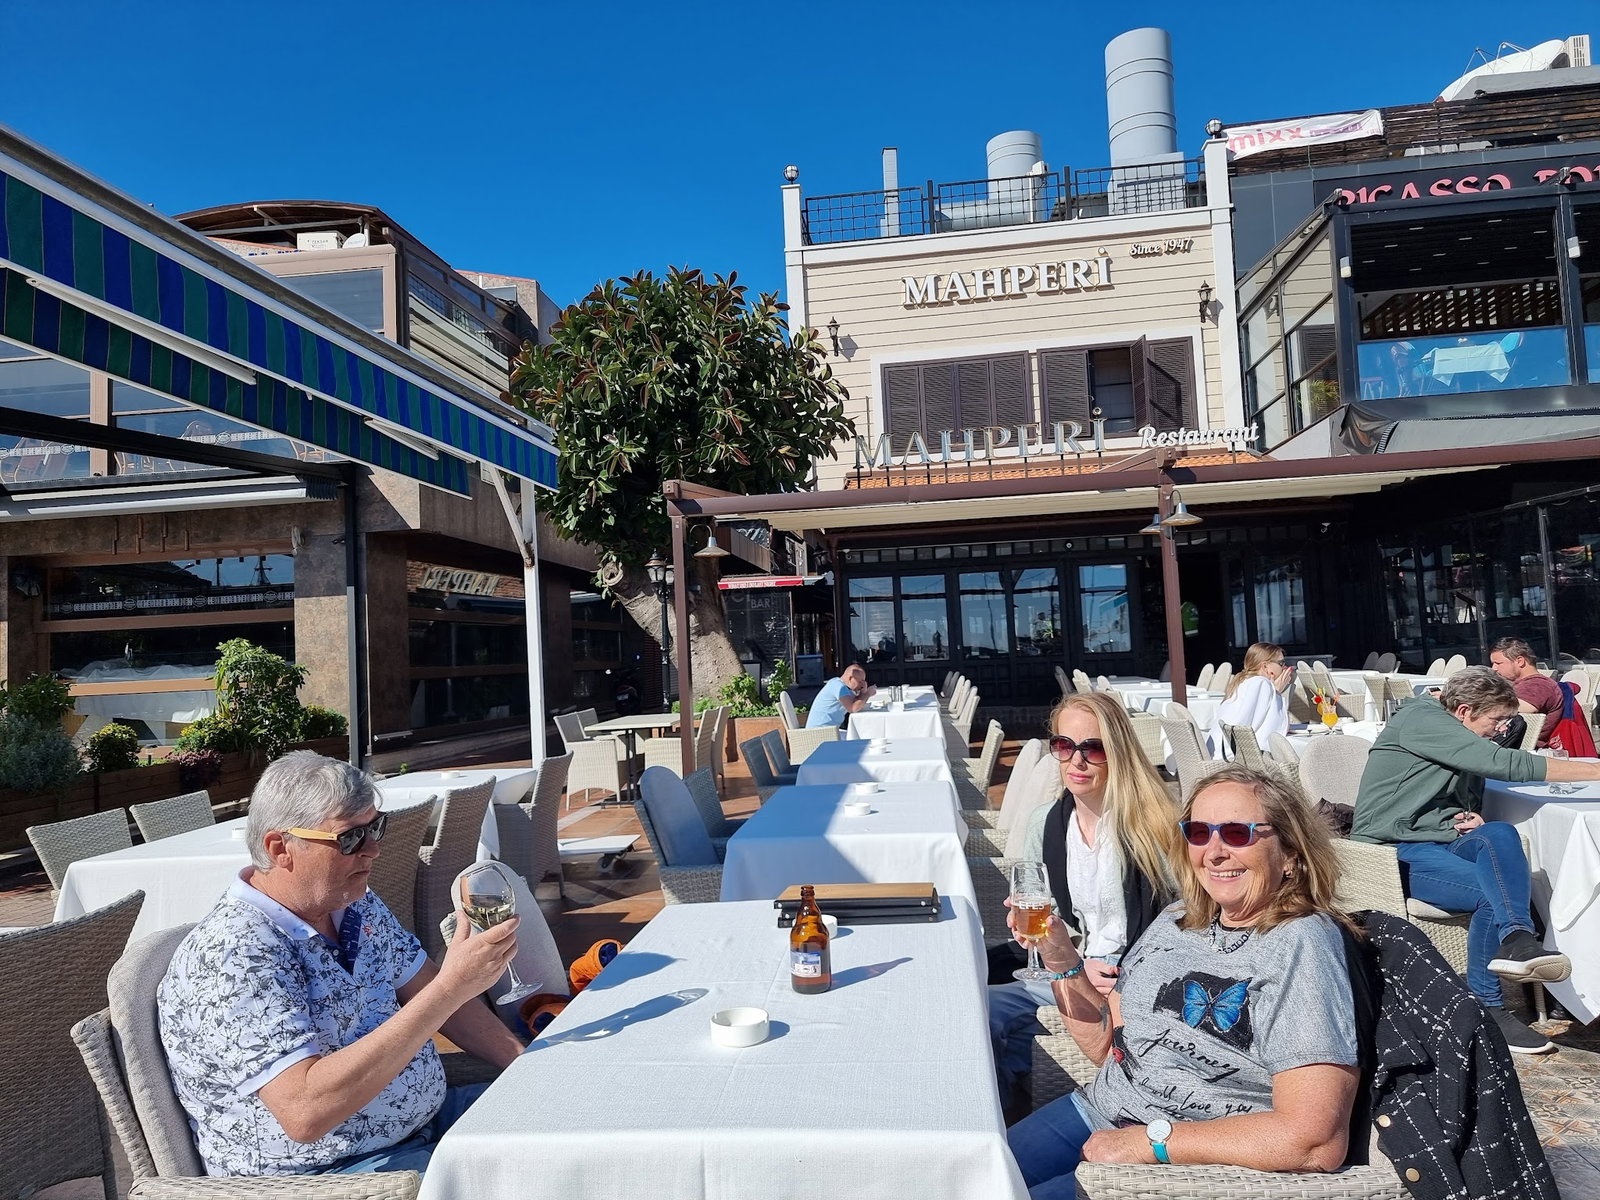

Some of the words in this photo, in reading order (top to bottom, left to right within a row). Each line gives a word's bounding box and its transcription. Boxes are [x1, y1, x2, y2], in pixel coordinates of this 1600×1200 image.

[1229, 127, 1304, 153] mixx
[1130, 242, 1162, 258] Since
[1164, 237, 1193, 254] 1947
[1138, 421, 1260, 449] Restaurant
[751, 597, 771, 609] BAR
